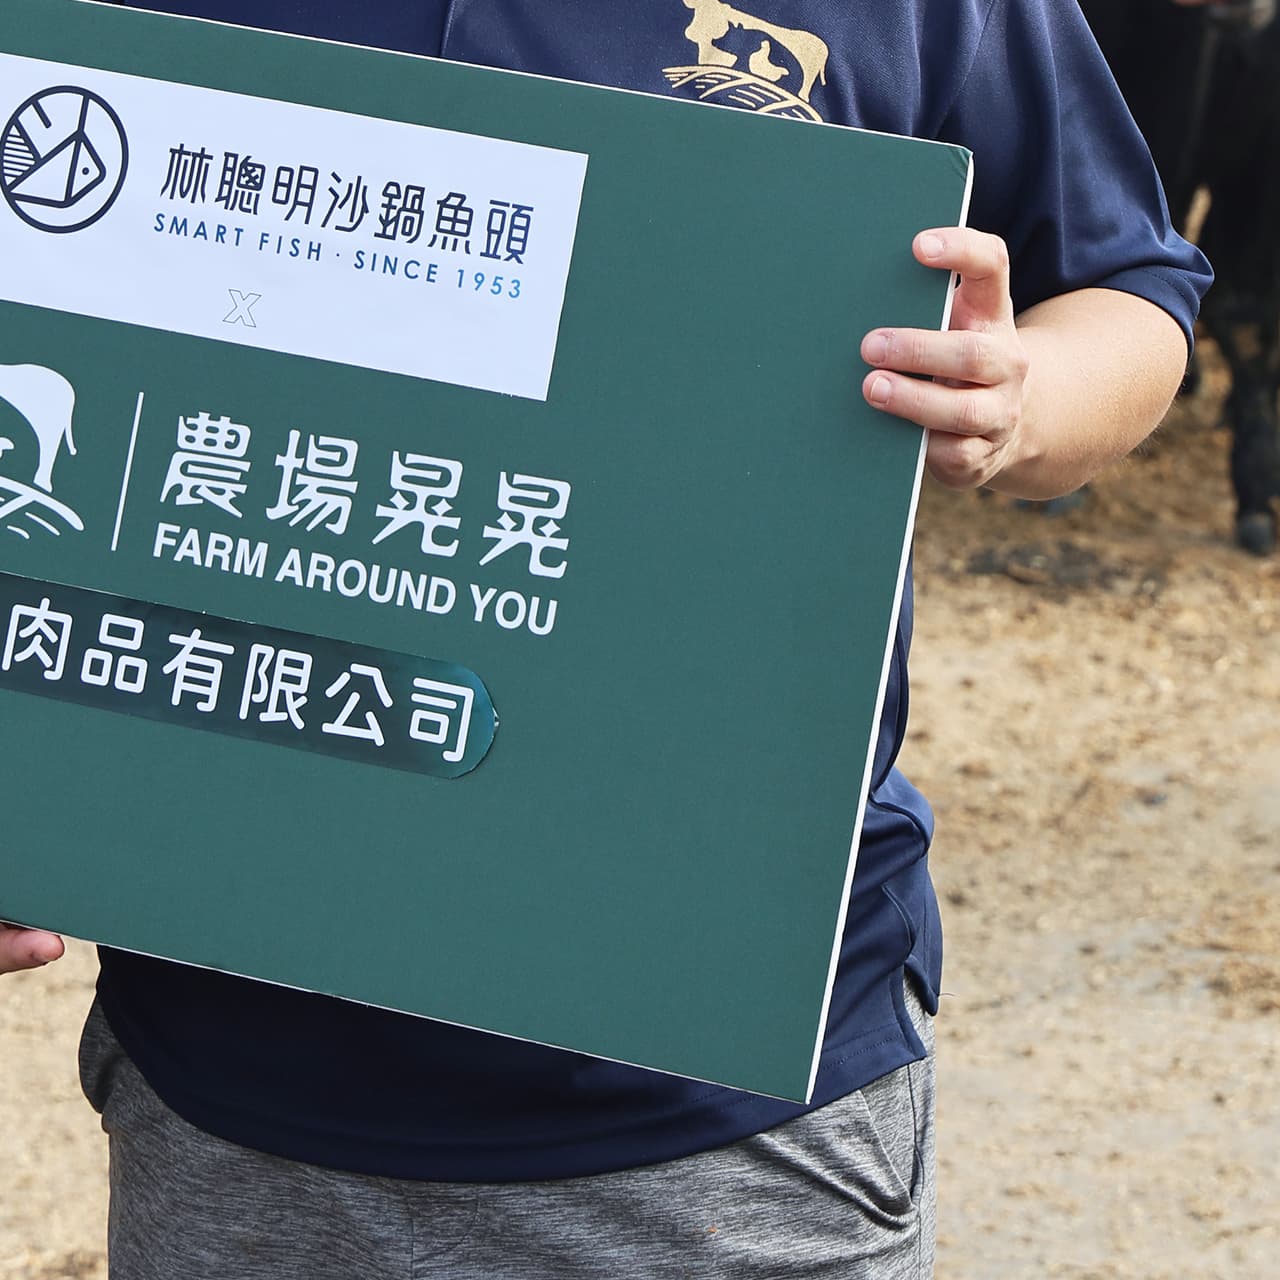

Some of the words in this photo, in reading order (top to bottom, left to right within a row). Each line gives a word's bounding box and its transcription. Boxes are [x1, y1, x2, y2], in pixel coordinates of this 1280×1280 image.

[153, 213, 245, 247] SMART
[259, 232, 322, 262] FISH
[353, 251, 439, 283] SINCE
[455, 269, 522, 299] 1953
[159, 143, 534, 264] 林聰明沙鍋魚頭
[159, 411, 571, 579] 農場晃晃
[153, 522, 269, 578] FARM
[275, 548, 456, 615] AROUND
[469, 584, 558, 636] YOU
